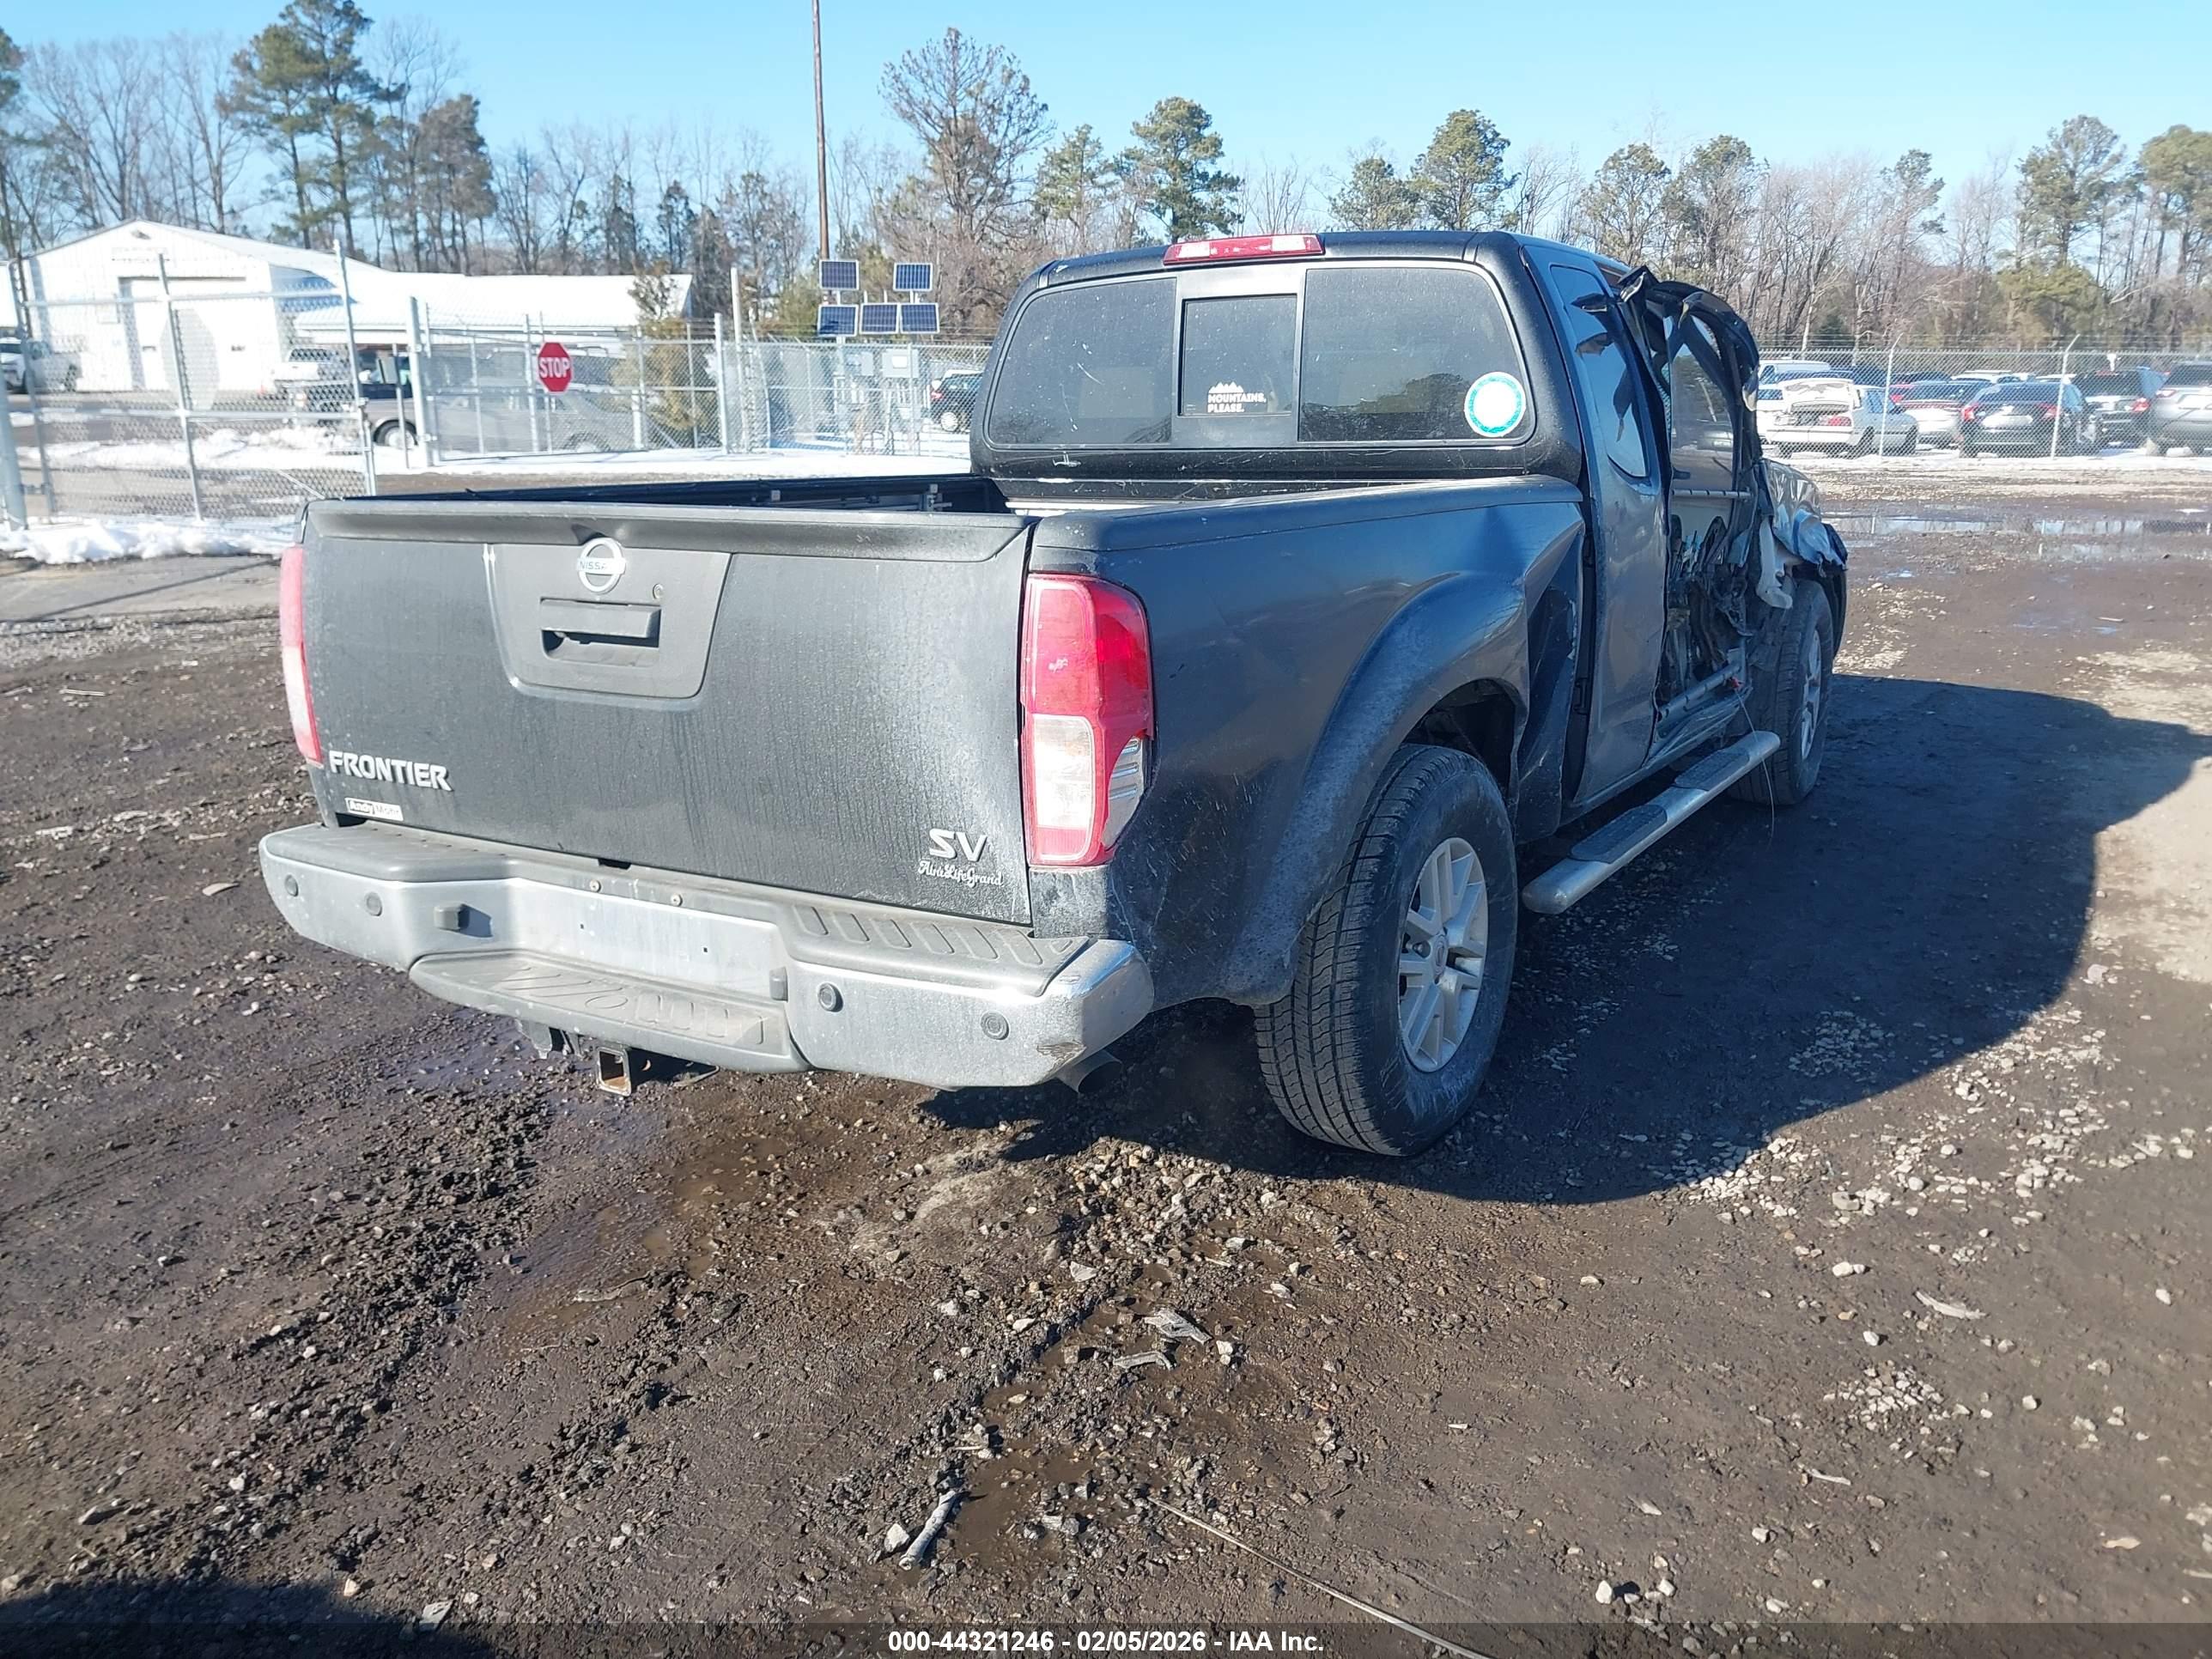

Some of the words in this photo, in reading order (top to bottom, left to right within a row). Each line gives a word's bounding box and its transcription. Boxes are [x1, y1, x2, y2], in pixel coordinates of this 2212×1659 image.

[539, 357, 570, 378] STOP
[1207, 392, 1267, 404] MOUNTAINS,
[1207, 403, 1245, 413] PLEASE.
[329, 750, 453, 792] FRONTIER
[929, 828, 988, 862] SV
